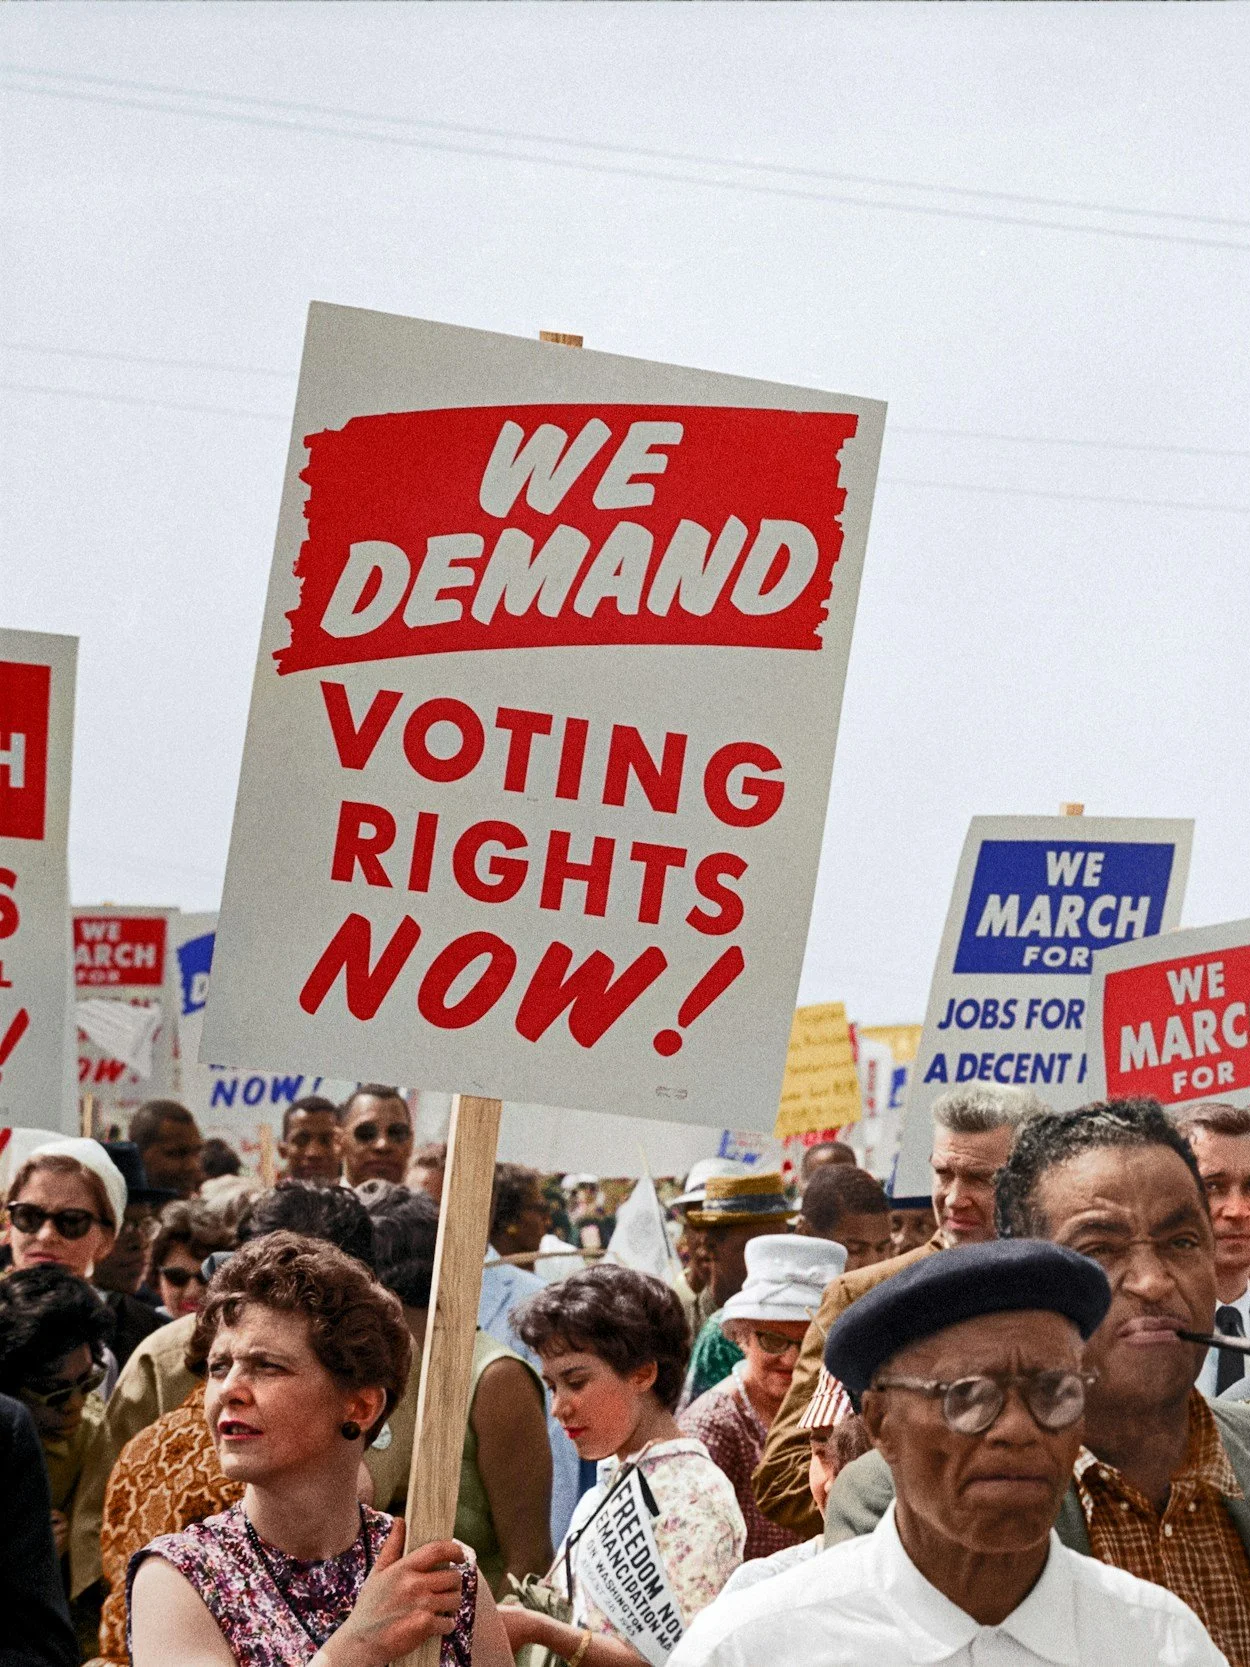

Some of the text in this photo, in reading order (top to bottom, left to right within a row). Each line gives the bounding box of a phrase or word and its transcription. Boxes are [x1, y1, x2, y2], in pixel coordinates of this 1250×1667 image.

[479, 417, 684, 519] WE
[319, 515, 820, 639] DEMAND
[320, 681, 786, 828] VOTING
[331, 801, 750, 937] RIGHTS
[1045, 850, 1105, 888] WE
[975, 894, 1151, 940] MARCH
[299, 912, 746, 1057] NOW!
[1022, 945, 1091, 969] FOR
[1166, 961, 1225, 1006] WE
[937, 998, 1085, 1030] JOBS FOR
[923, 1052, 948, 1083] A
[955, 1052, 1072, 1084] DECENT
[1171, 1061, 1235, 1095] FOR
[596, 1511, 661, 1632] EMANCIPATION
[611, 1480, 664, 1600] FREEDOM
[596, 1563, 644, 1633] WASHINGTON
